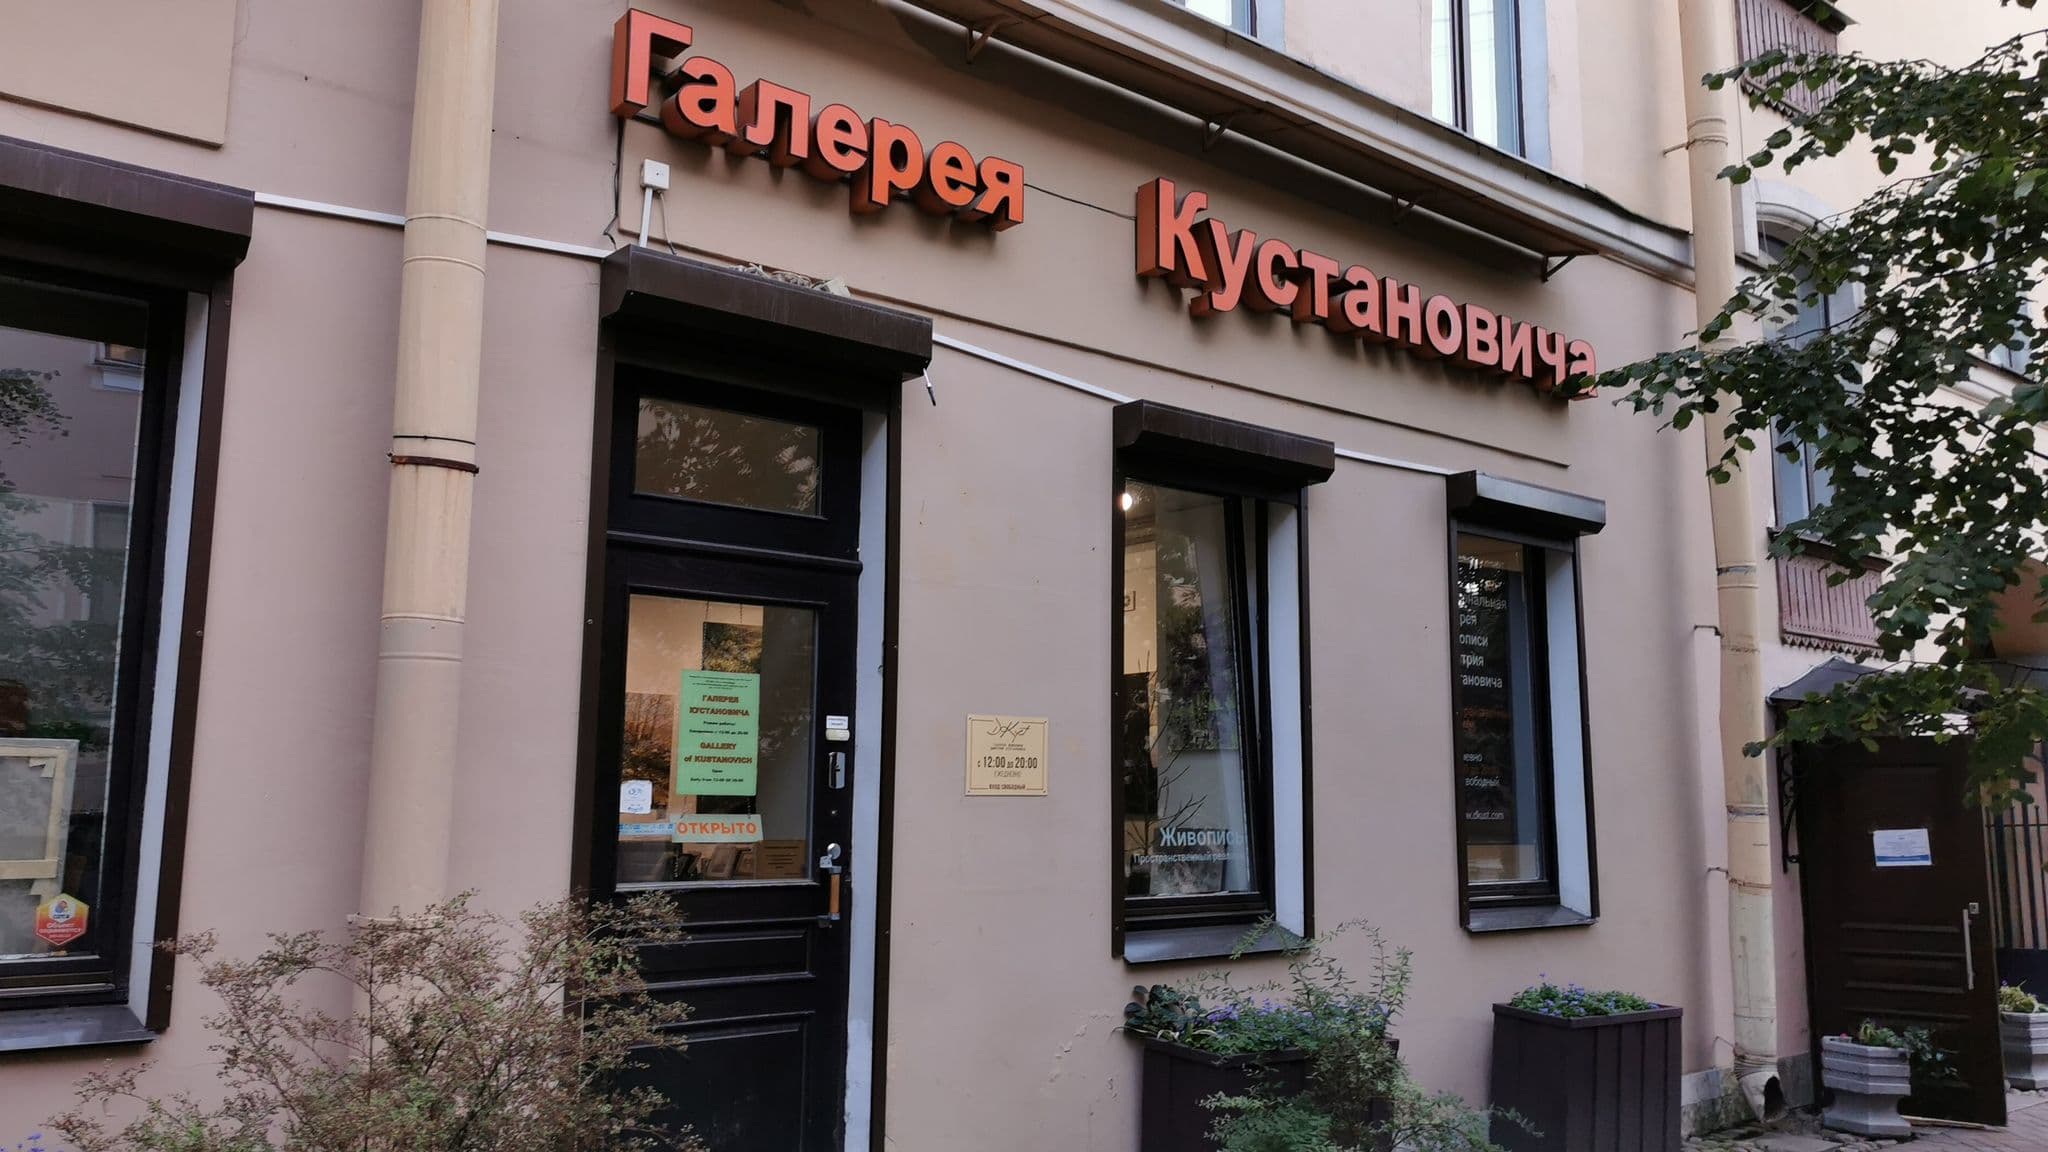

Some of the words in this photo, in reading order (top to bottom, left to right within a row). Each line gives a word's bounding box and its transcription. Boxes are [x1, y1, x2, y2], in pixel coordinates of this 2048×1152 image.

[613, 8, 1025, 230] Галерея
[1138, 176, 1598, 400] Кустановича
[1459, 633, 1488, 647] описи
[702, 694, 739, 703] ГАЛЕРЕЯ
[689, 706, 750, 717] КУСТАНОВИЧА
[700, 741, 737, 750] GALLERY
[684, 754, 693, 763] of
[694, 755, 753, 764] KUSTANOVICH
[983, 755, 1006, 768] 12:00
[1014, 756, 1038, 769] 20:00
[676, 821, 757, 835] ОТКРЫТО
[1160, 826, 1244, 847] Живопись
